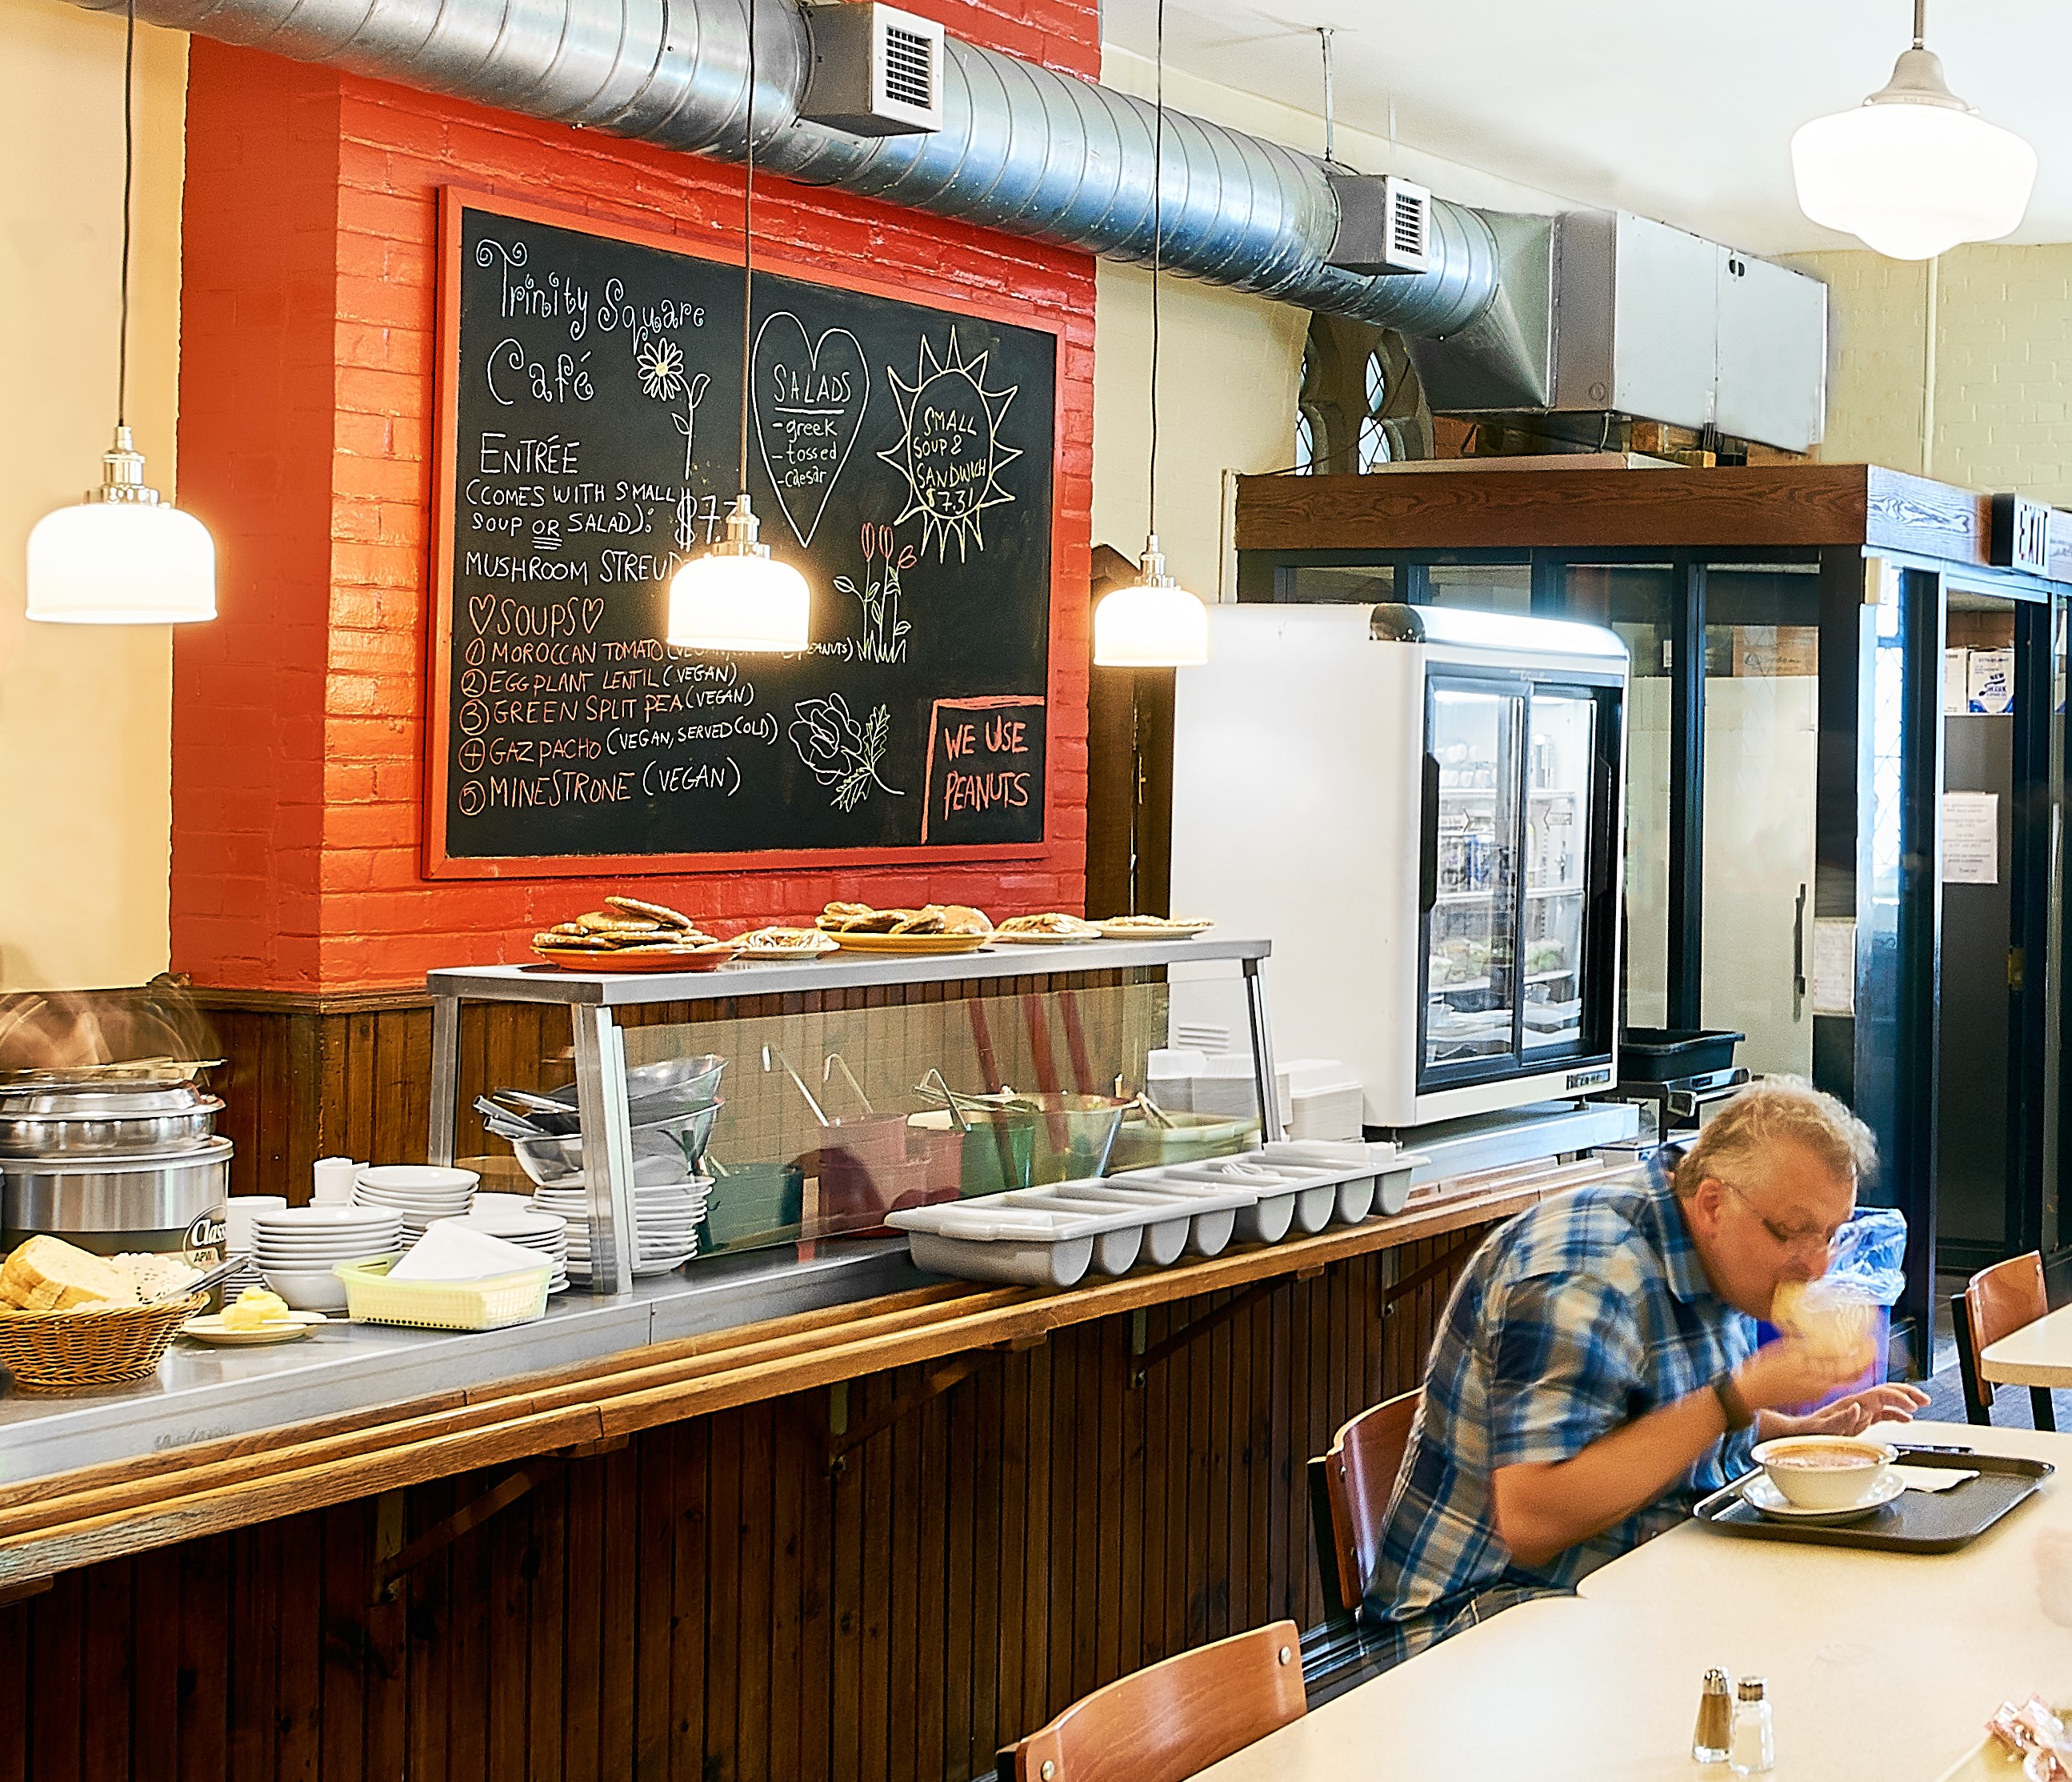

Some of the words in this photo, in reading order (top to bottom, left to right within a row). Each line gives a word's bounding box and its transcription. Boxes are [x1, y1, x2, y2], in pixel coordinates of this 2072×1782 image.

[476, 239, 588, 340] Trinity
[598, 278, 705, 354] Square
[487, 338, 594, 404] Café
[774, 364, 851, 403] SALADS
[923, 406, 977, 436] SMALL
[481, 433, 579, 474] ENTRÉE
[913, 437, 947, 459] SOUP
[950, 434, 962, 455] &
[917, 459, 986, 489] SANDWICH
[466, 479, 545, 507] (COMES
[553, 483, 604, 504] WITH
[616, 481, 675, 503] SMALL
[472, 513, 522, 536] SOUP
[532, 520, 559, 537] OR
[567, 504, 654, 535] SALAD):
[2018, 503, 2048, 567] EXIT
[466, 551, 588, 585] MUSHROOM
[599, 549, 690, 583] STREUD
[497, 597, 579, 638] SOUPS
[491, 641, 597, 665] MOROCCAN
[602, 639, 663, 661] TOMATO
[602, 667, 659, 690] LENTIL
[663, 663, 737, 687] (VEGAN)
[494, 699, 578, 724] GREEN
[586, 695, 638, 722] SPLIT
[644, 694, 683, 723] PEA
[686, 683, 754, 708] (VEGAN)
[606, 727, 674, 755] (VEGAN,
[678, 722, 733, 743] SERVED
[944, 723, 976, 762] WE
[985, 715, 1030, 754] USE
[490, 769, 636, 808] MINESTRONE
[642, 756, 741, 796] (VEGAN)
[944, 770, 1031, 821] PEANUTS
[191, 1218, 227, 1247] Clas
